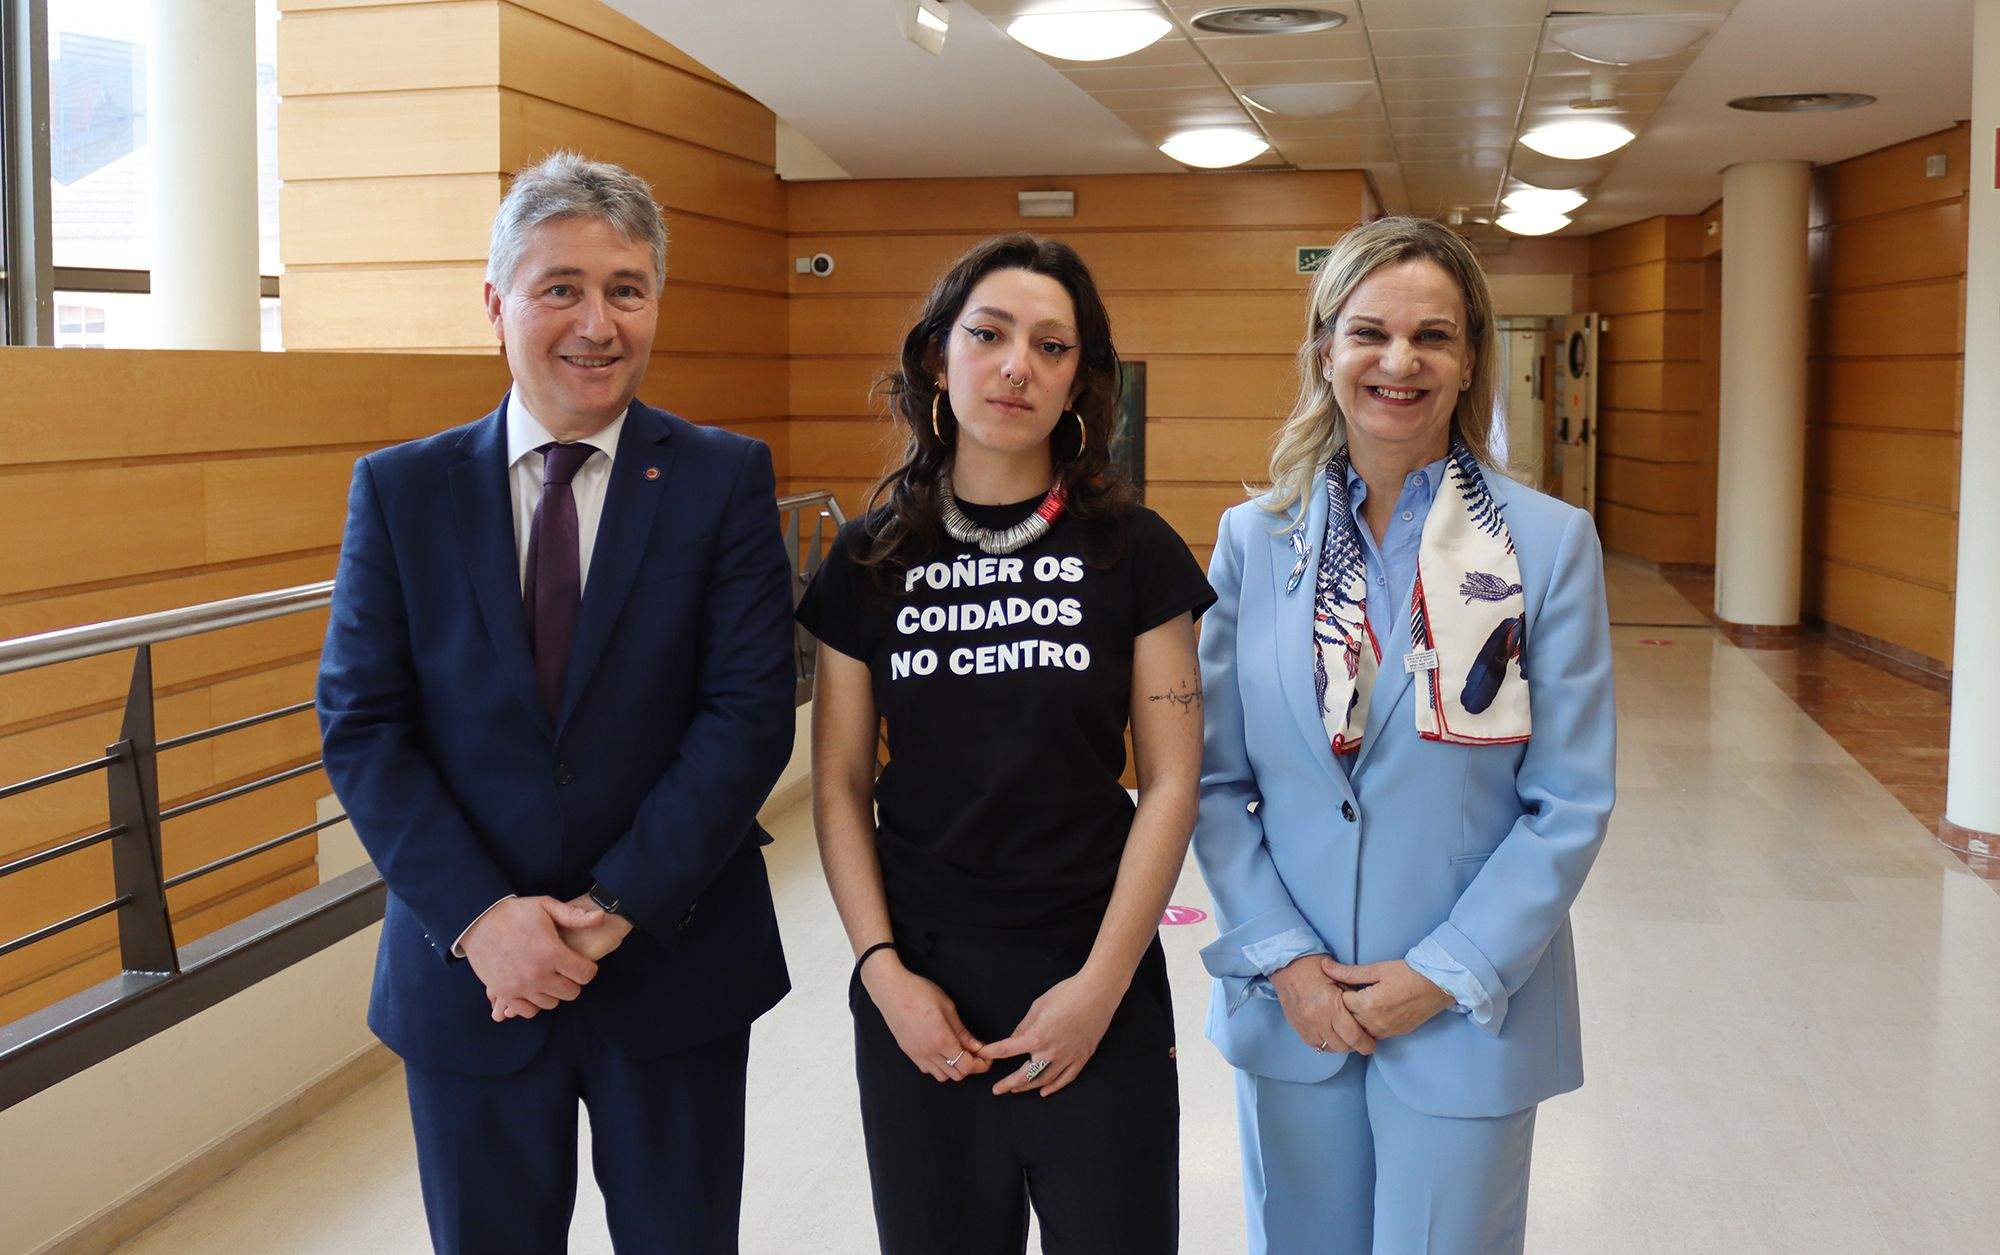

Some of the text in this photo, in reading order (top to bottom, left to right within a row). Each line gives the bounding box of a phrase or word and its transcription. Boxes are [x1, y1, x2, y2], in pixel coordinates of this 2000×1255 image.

[904, 553, 1084, 592] POÑER OS
[896, 597, 1083, 635] COIDADOS
[890, 639, 1091, 681] NO CENTRO
